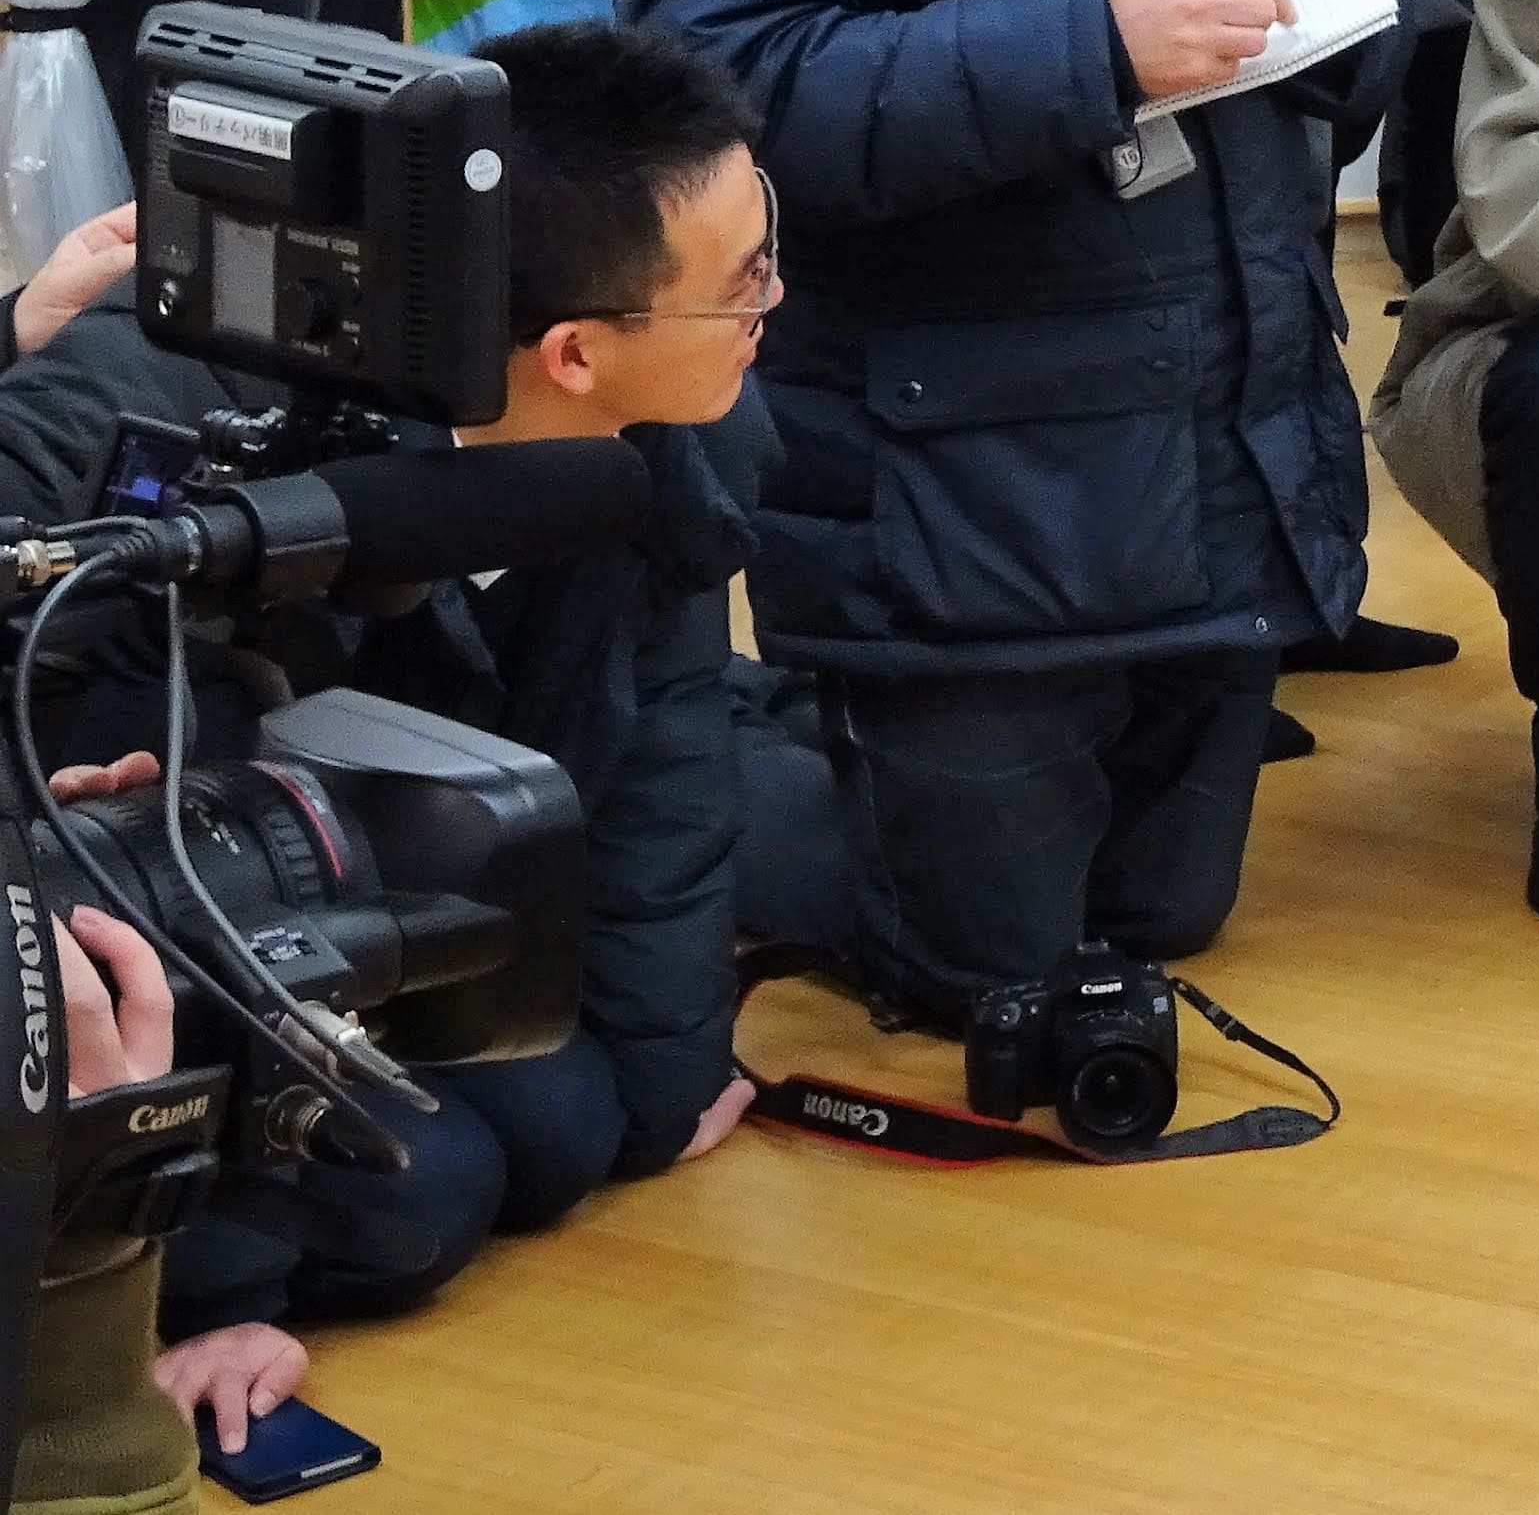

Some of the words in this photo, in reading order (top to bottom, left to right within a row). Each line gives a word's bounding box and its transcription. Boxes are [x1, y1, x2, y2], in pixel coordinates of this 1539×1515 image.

[6, 884, 50, 1114] Canon
[1081, 981, 1122, 995] Canon
[128, 1095, 210, 1133] Canon
[803, 1092, 889, 1137] Canon
